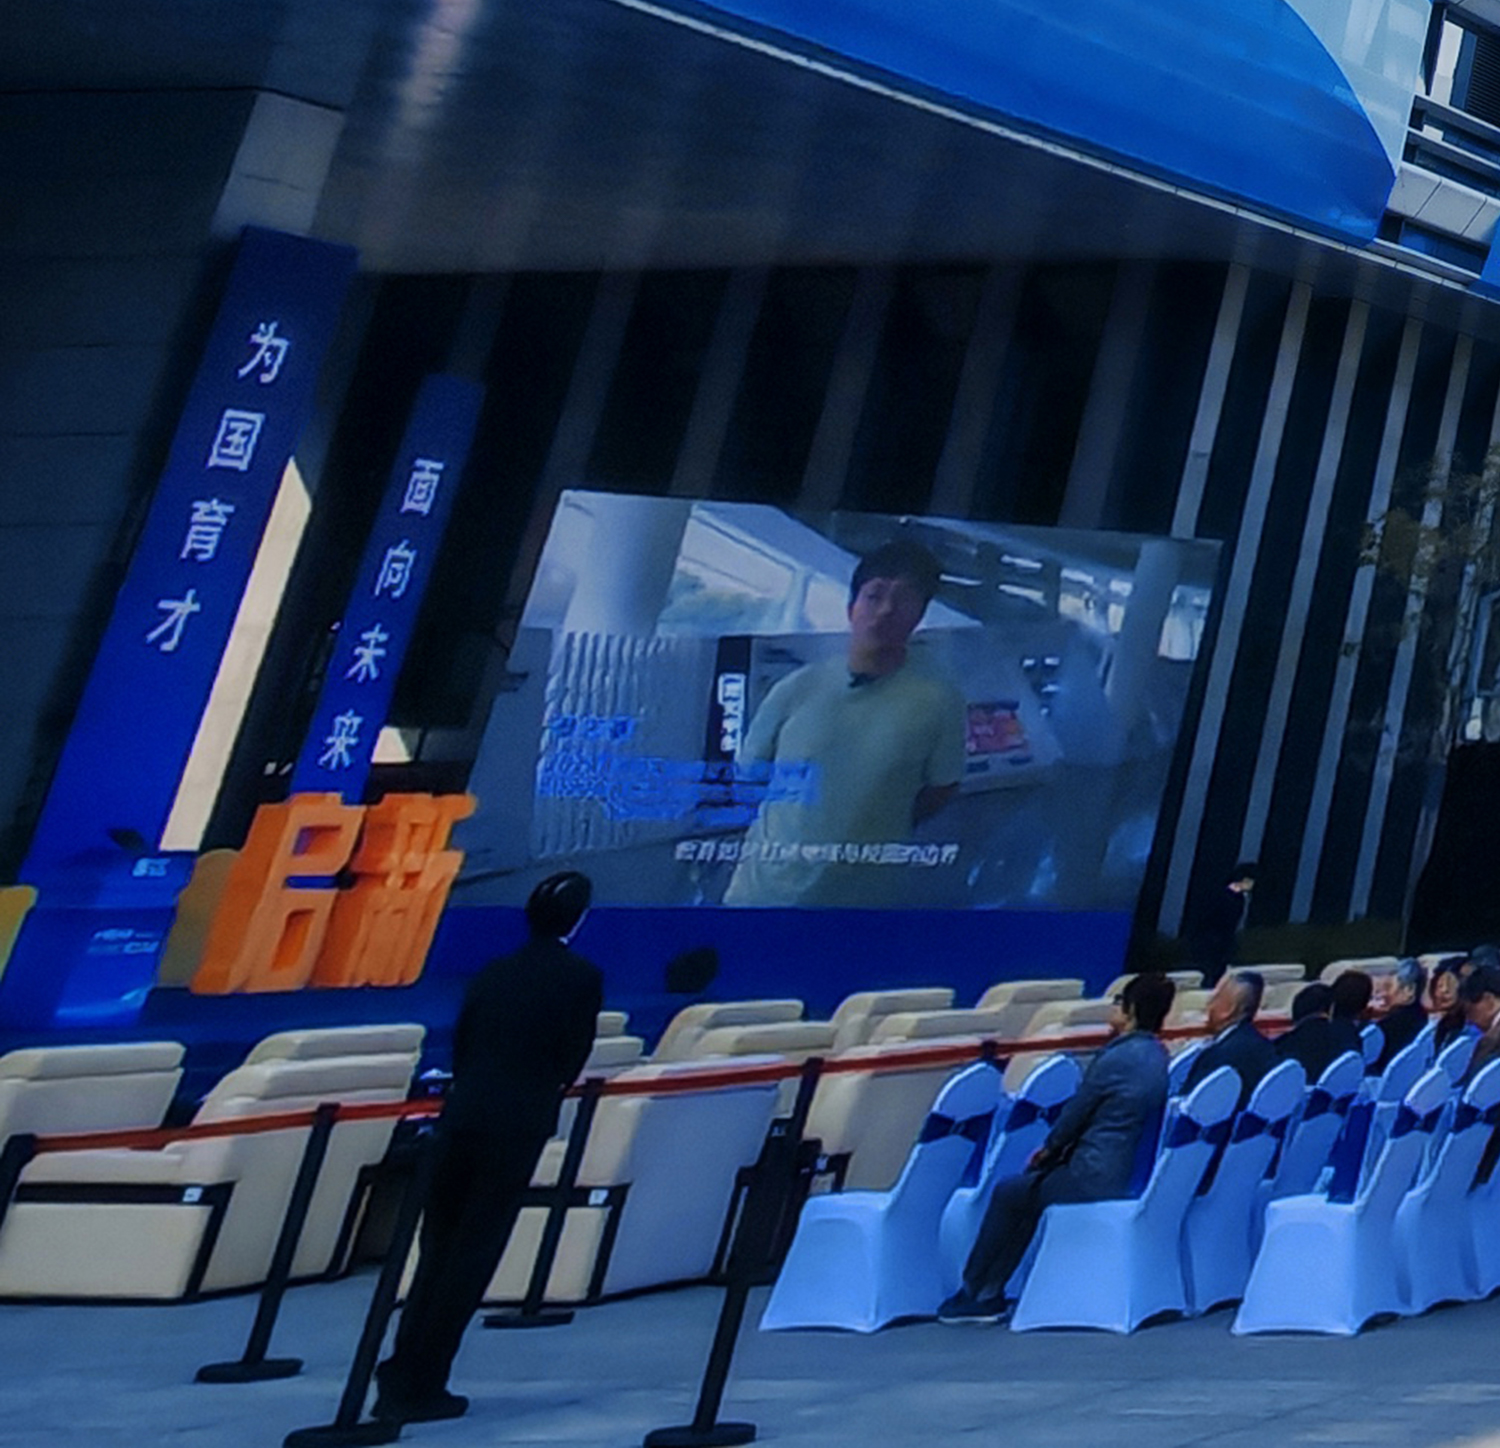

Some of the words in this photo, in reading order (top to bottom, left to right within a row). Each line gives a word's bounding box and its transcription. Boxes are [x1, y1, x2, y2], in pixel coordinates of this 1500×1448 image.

[146, 320, 291, 652] 为国育才
[318, 458, 444, 772] 面向未来
